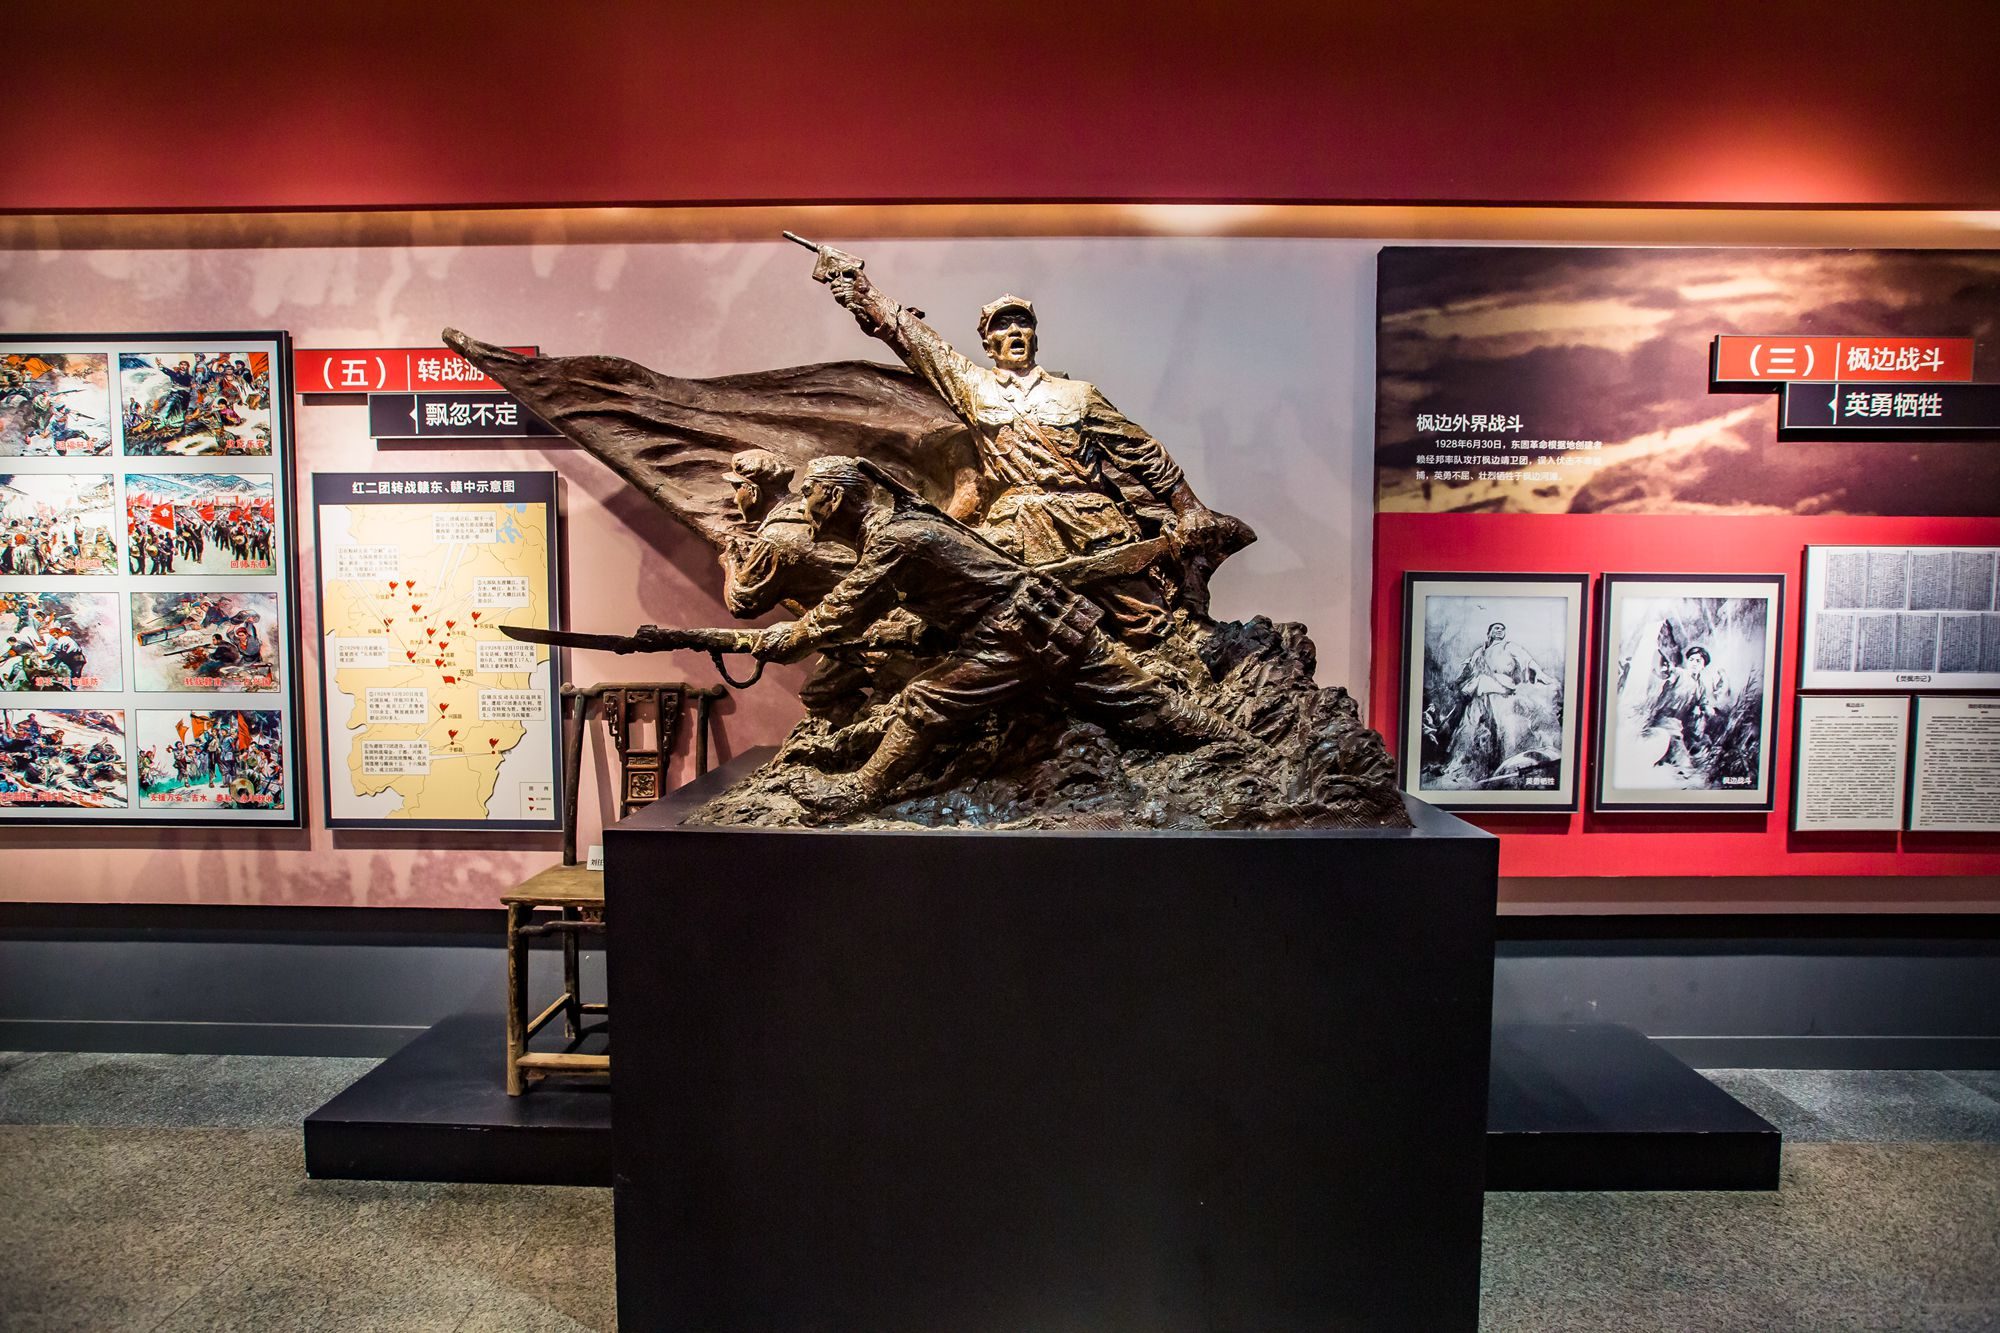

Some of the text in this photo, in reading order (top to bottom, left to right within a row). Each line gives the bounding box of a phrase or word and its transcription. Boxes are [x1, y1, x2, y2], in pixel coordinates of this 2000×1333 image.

[1847, 346, 1945, 373] 枫边战斗
[417, 357, 496, 383] 转战游
[425, 402, 518, 427] 飘忽不定
[1844, 392, 1943, 418] 英勇牺牲
[1416, 414, 1524, 433] 枫边外界战斗
[1416, 455, 1603, 466] 赖经邦率队攻打枫边靖卫团，误入伏击不
[352, 480, 515, 494] 红二团转战赣东、赣中示意图
[1525, 777, 1555, 786] 英勇牺牲
[1722, 776, 1752, 785] 枫边战斗
